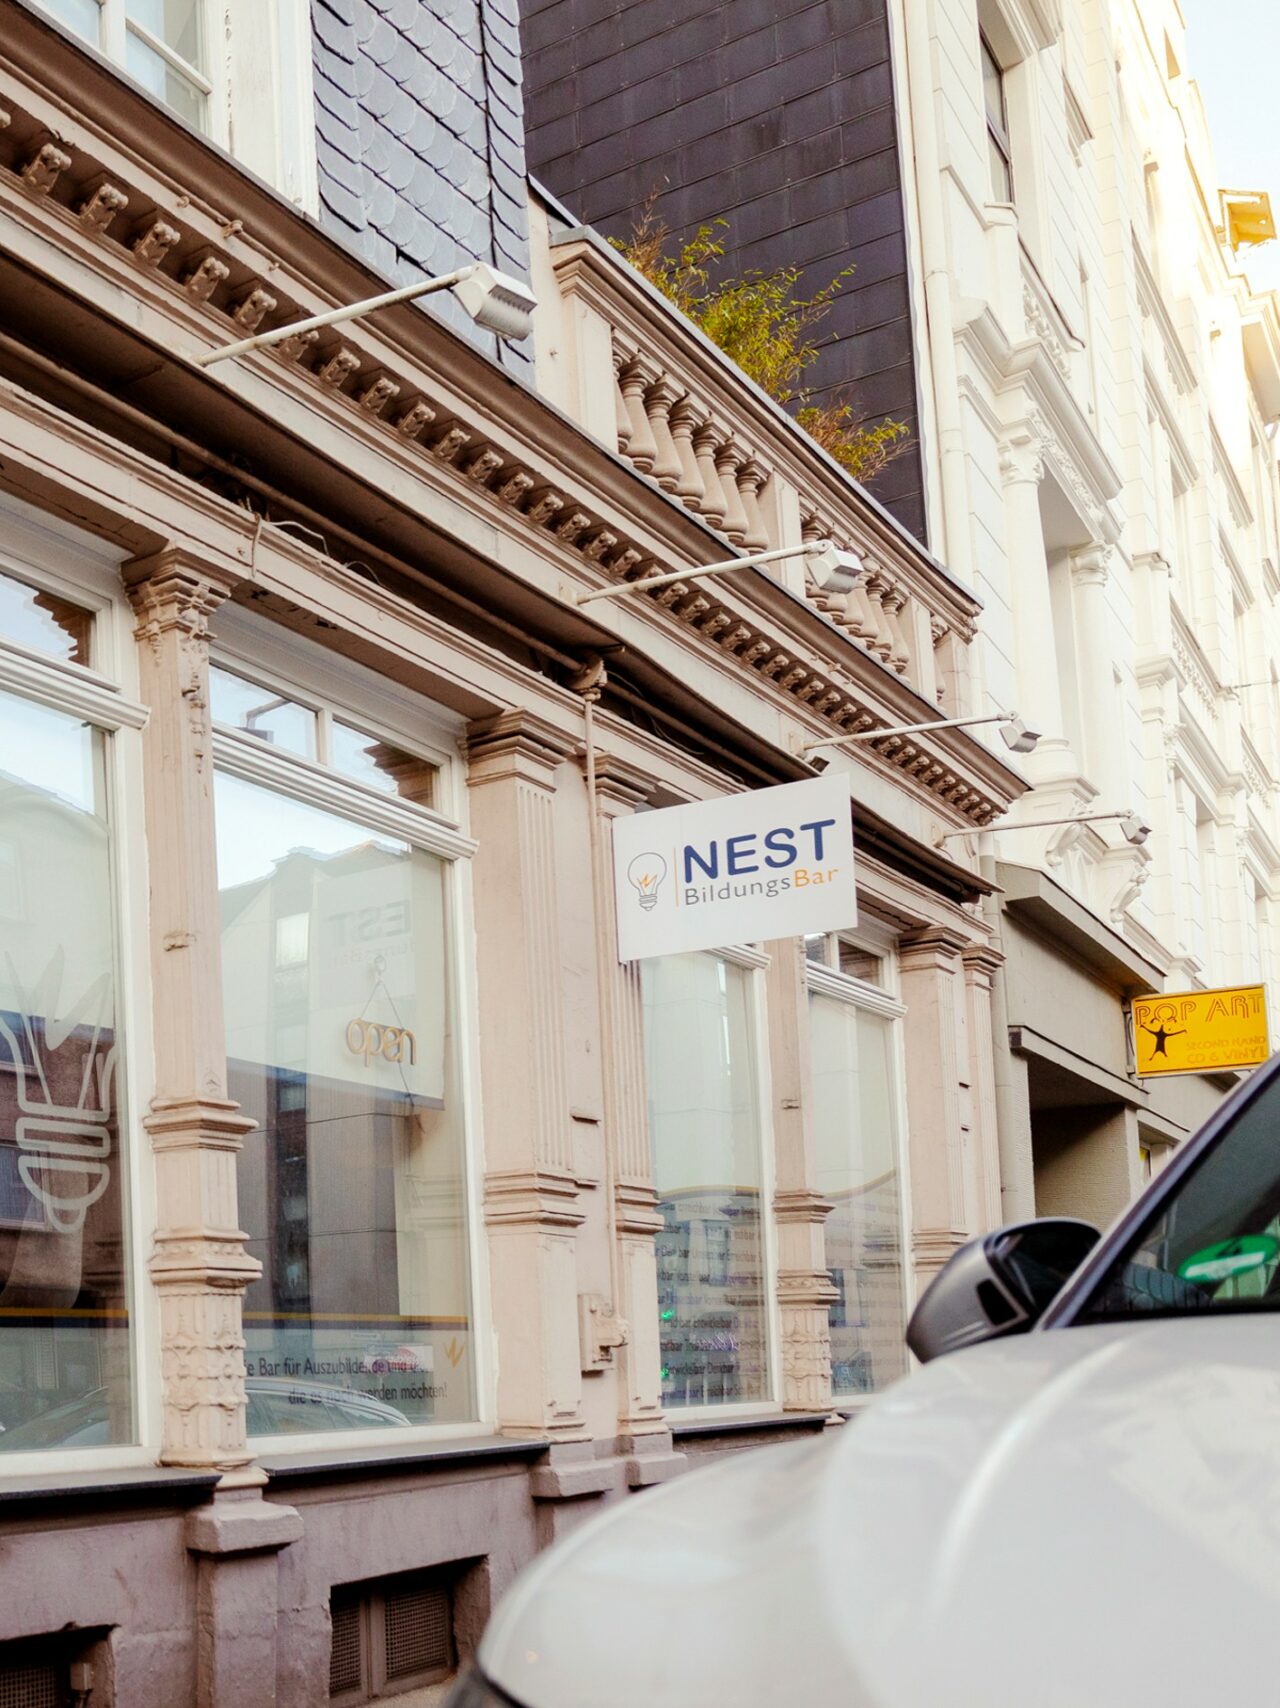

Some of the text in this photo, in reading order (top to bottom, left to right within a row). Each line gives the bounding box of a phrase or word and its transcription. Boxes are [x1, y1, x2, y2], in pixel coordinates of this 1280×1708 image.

[684, 819, 836, 884] NEST
[685, 868, 839, 906] BildungsBar
[1205, 994, 1265, 1023] ART
[259, 1357, 280, 1376] Bar
[283, 1356, 302, 1375] für
